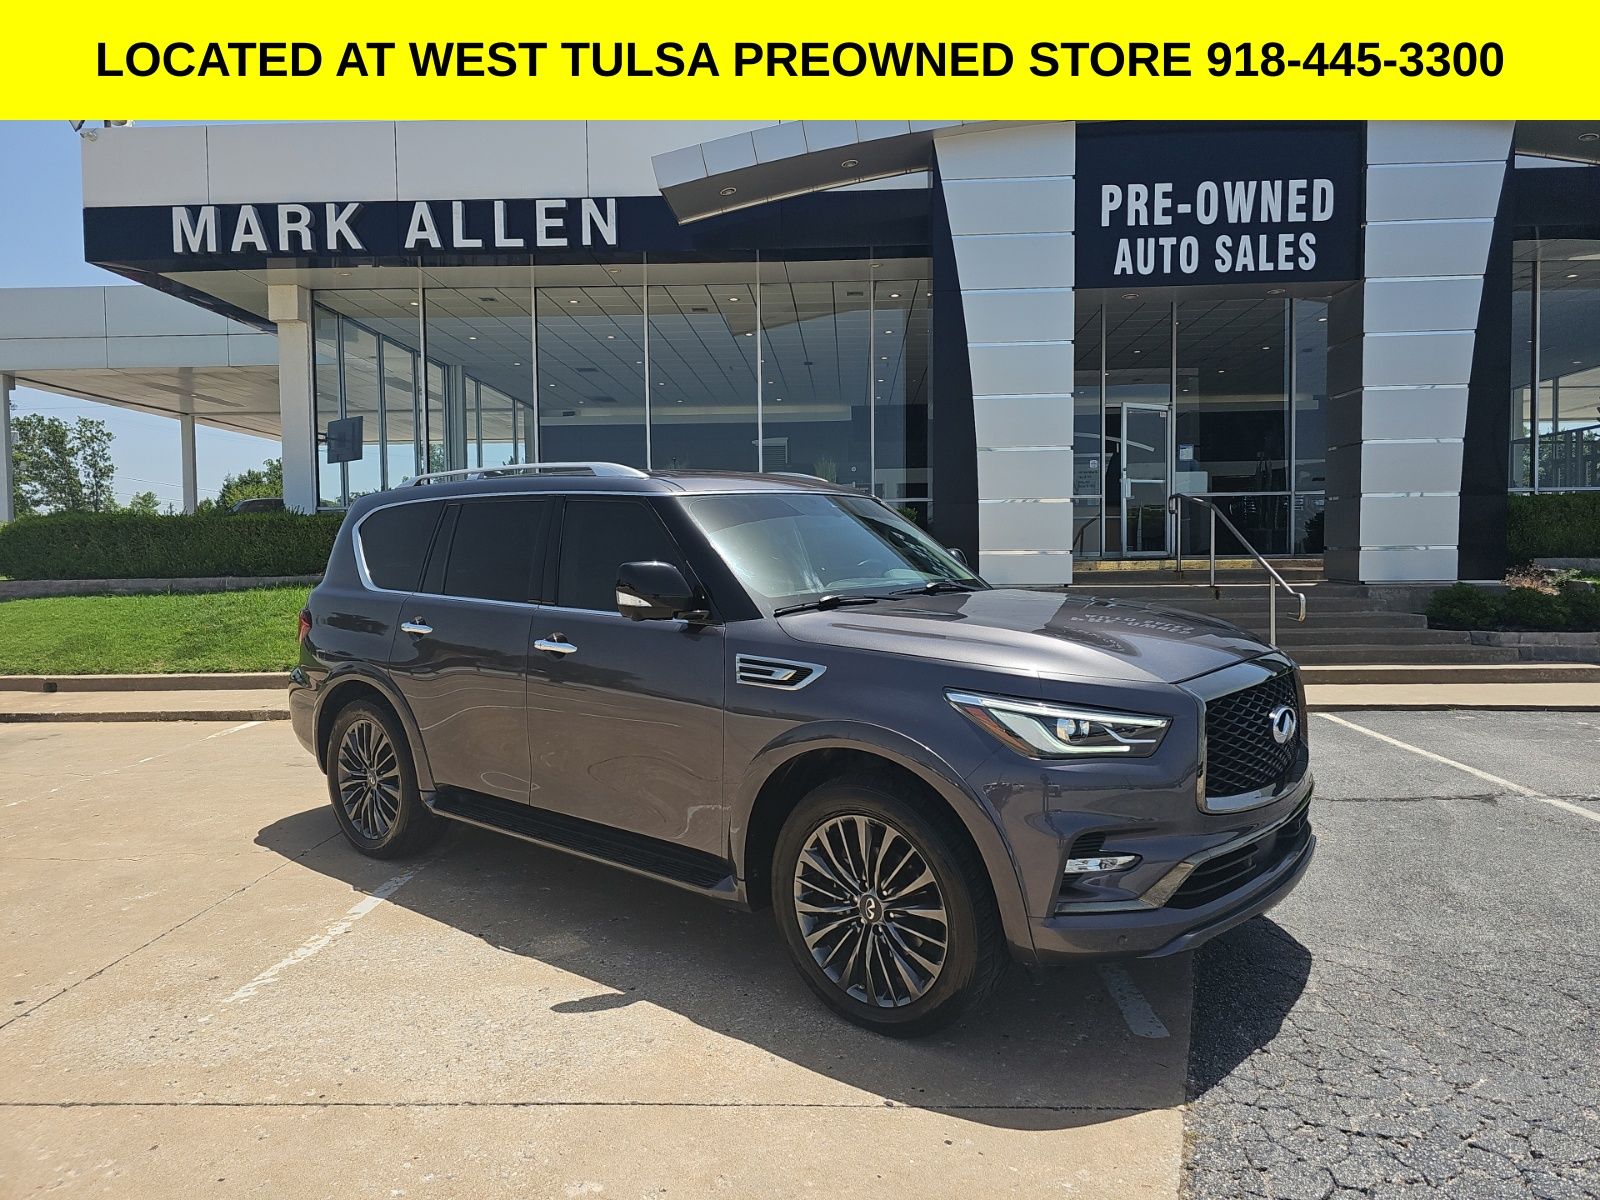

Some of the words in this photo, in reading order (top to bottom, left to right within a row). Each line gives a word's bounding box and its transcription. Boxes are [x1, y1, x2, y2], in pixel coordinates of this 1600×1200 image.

[172, 202, 364, 253] MARK
[405, 198, 619, 249] ALLEN
[1101, 179, 1334, 227] PRE-OWNED
[1114, 236, 1199, 275] AUTO
[1214, 232, 1316, 273] SALES
